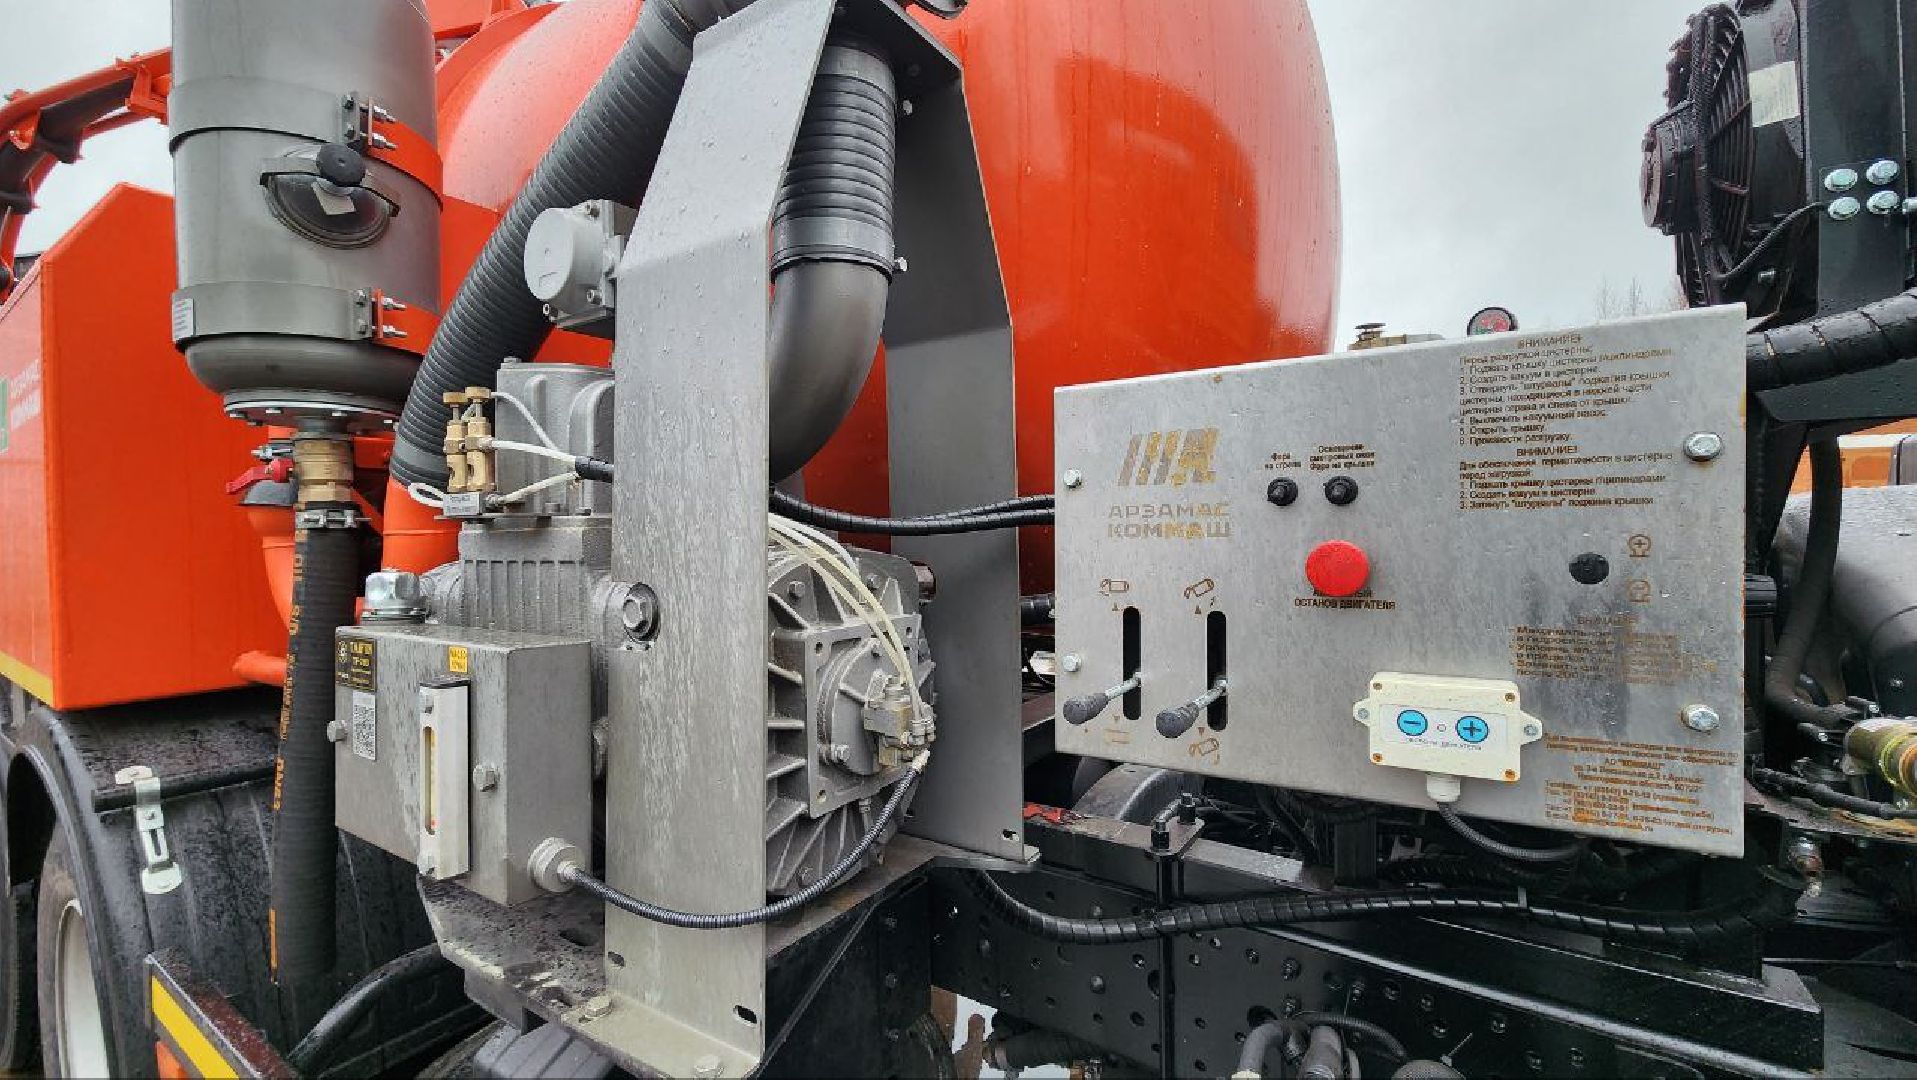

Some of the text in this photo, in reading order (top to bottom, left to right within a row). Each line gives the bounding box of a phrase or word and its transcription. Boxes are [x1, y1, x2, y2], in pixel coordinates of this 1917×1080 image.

[1109, 502, 1229, 519] АРЗАМАС
[1107, 521, 1230, 539] КОММАШ
[1294, 598, 1397, 610] ОСТАНОВ ДВИГАТЕЛЯ
